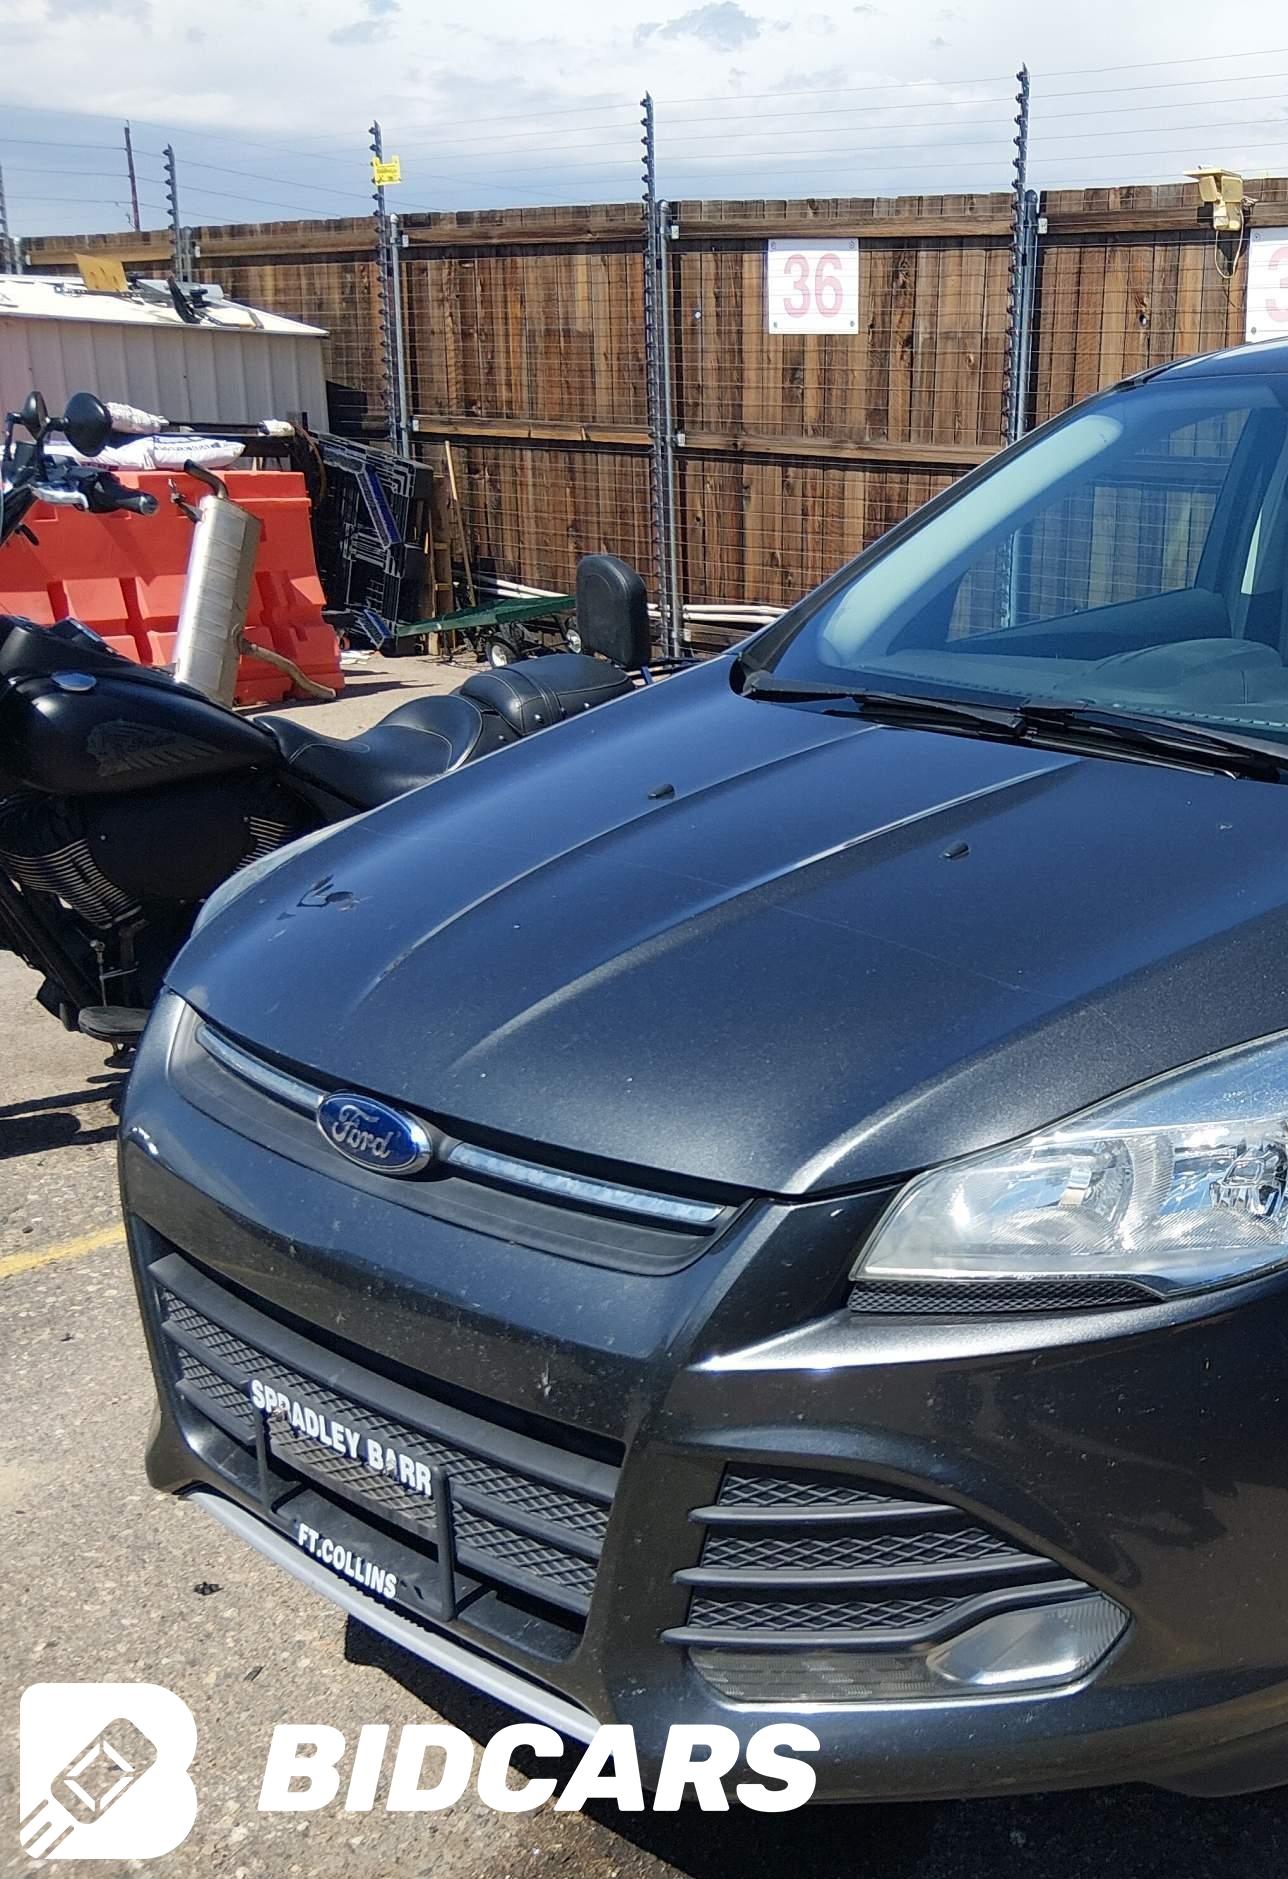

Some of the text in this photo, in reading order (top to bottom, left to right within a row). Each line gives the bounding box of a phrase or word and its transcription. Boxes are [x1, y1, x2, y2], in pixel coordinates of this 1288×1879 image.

[783, 253, 843, 318] 36
[331, 1104, 395, 1159] Ford
[251, 1379, 432, 1496] SPRADLEY BARR
[298, 1522, 399, 1599] FT.COLLINS
